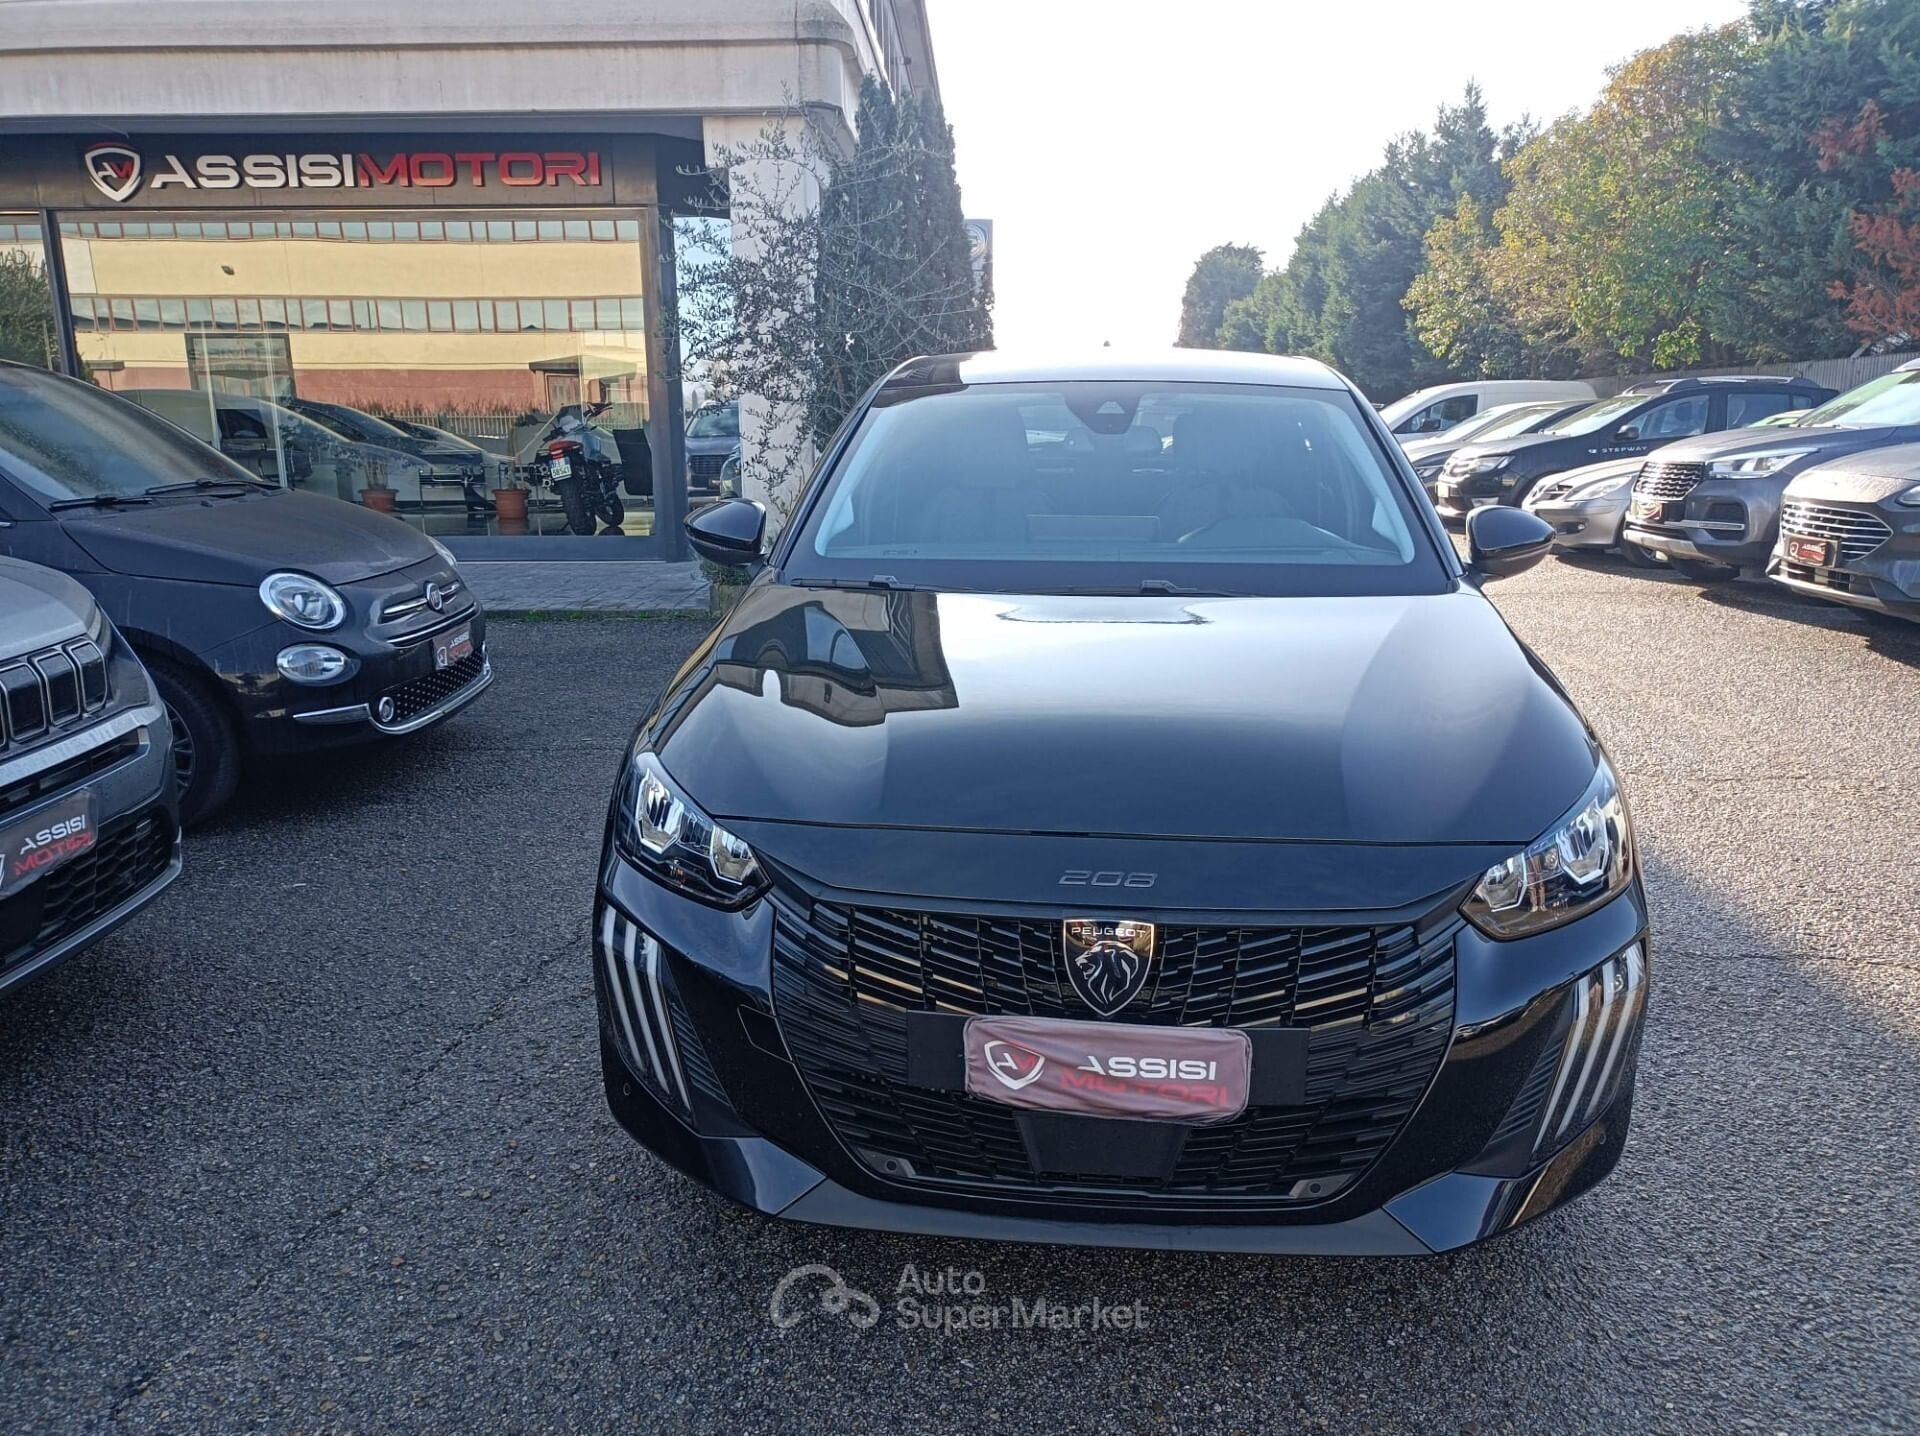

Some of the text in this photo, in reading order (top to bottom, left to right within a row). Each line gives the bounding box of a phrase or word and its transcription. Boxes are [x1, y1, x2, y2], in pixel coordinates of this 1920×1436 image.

[1601, 446, 1647, 454] STEPWAY
[20, 814, 86, 855] ASSISI
[1058, 870, 1158, 888] 208
[1071, 926, 1146, 937] PEUGEOT
[1076, 1056, 1216, 1081] ASSISI
